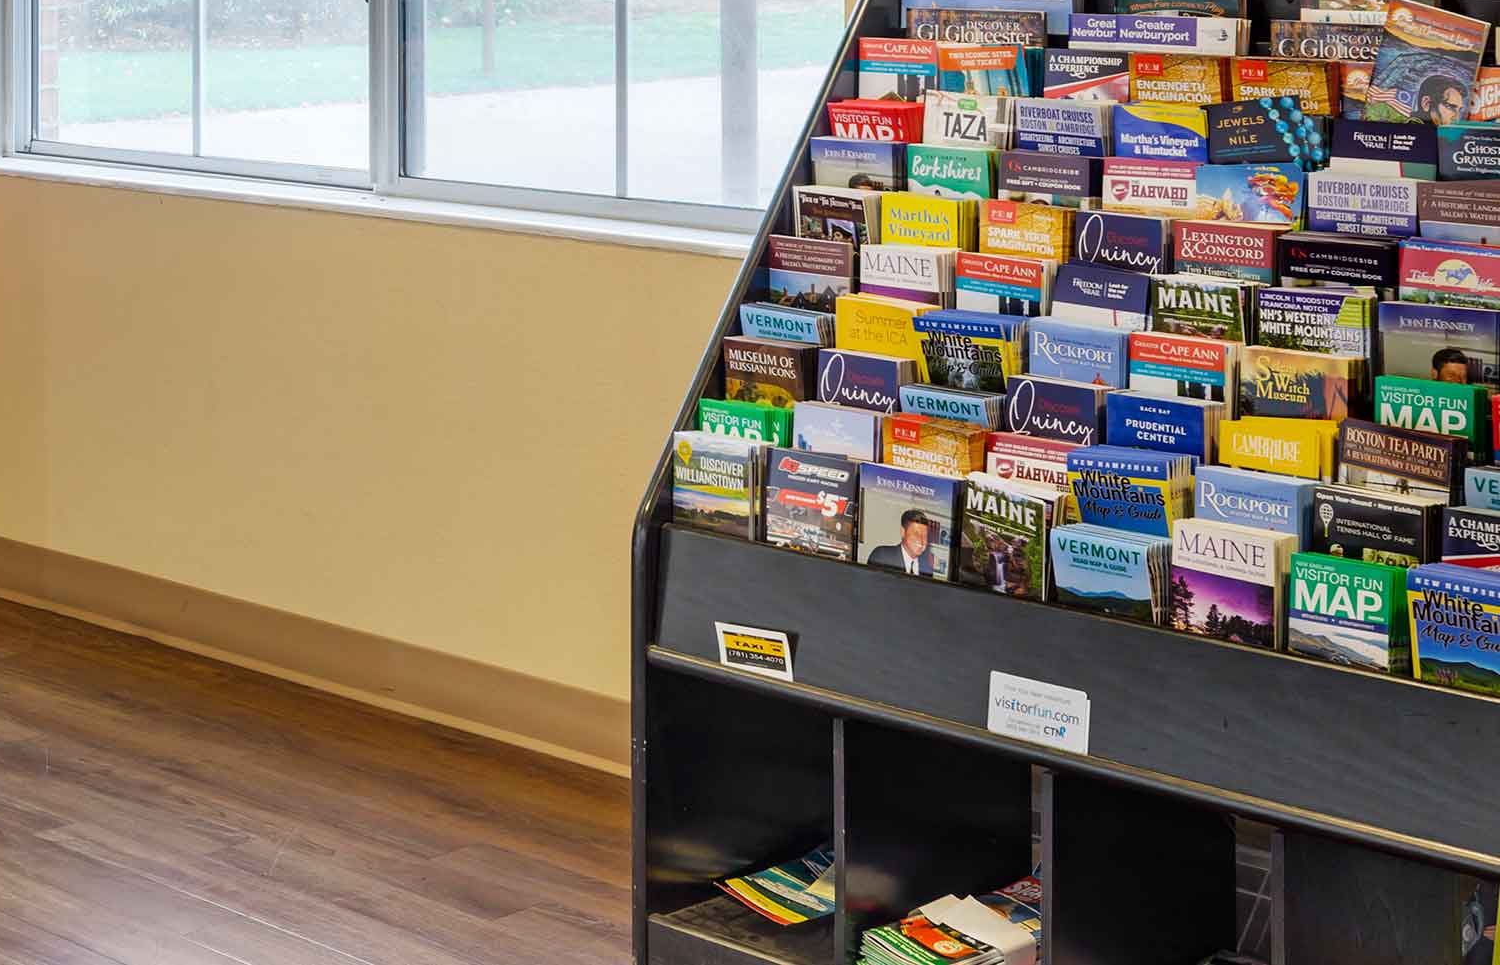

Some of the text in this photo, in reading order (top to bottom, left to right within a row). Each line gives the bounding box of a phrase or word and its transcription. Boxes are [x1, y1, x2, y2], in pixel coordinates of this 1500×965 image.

[945, 24, 1033, 44] Gloucester
[966, 20, 1020, 31] DISCOVER
[1134, 20, 1175, 31] Greater
[1120, 29, 1190, 42] Newburyport
[884, 43, 932, 54] CAPE ANN
[1058, 56, 1123, 66] CHAMPIONSHIP
[1050, 64, 1099, 78] EXPERIENCE
[1240, 86, 1276, 97] SPARK
[832, 113, 892, 125] VISITOR FUN
[1020, 106, 1094, 124] RIVERBOAT CRUISES
[1216, 116, 1265, 129] JEWELS
[834, 123, 894, 141] MAP
[943, 112, 987, 142] TAZA
[1020, 118, 1095, 135] BOSTON CAMBRIDGE
[1058, 137, 1096, 147] ARCHITECTURE
[1121, 134, 1199, 148] Martha's Vineyard
[1229, 134, 1258, 145] NILE
[1353, 132, 1387, 143] FREEDOM
[824, 148, 842, 158] JOHN
[1038, 144, 1080, 155] SUNSET CRUISES
[1142, 148, 1187, 157] Nantucket
[912, 155, 981, 181] Berkshires
[1023, 165, 1079, 175] CAMBRIDGESIDE
[1007, 178, 1023, 186] FREE
[1038, 181, 1064, 189] COUPON
[1132, 185, 1187, 199] HARVARD
[1317, 181, 1409, 199] RIVERBOAT CRUISES
[1317, 196, 1409, 212] BOSTON CAMBRIDGE
[890, 208, 948, 224] Martha's
[1316, 211, 1409, 227] SIGHTSEEING ARCHITECTURE
[888, 223, 951, 242] Vineyard
[988, 226, 1049, 239] SPARK YOUR
[1181, 227, 1264, 248] LEXINGTON
[1336, 223, 1388, 235] SUNSET CRUISES
[988, 239, 1054, 254] IMAGINATION
[1078, 213, 1162, 275] Quincy
[865, 251, 932, 278] MAINE
[1309, 252, 1378, 265] CAMBRIDGESIDE
[984, 261, 1010, 274] CAPE
[1012, 265, 1036, 278] ANN
[1187, 265, 1202, 274] Two
[1331, 270, 1361, 278] COUPON
[1362, 273, 1383, 281] BOOK
[1073, 278, 1103, 291] FREEDOM
[1158, 287, 1234, 318] MAINE
[1260, 293, 1341, 306] LINCOLN WOODSTOCK
[1260, 301, 1300, 310] FRANCONIA
[745, 313, 813, 335] VERMONT
[855, 310, 907, 328] Summer
[1260, 309, 1331, 325] NH'S WESTERN
[1400, 316, 1475, 332] JOHN KENNEDY
[941, 322, 996, 332] HAMPSHIRE
[1260, 321, 1360, 343] WHITE MOUNTAINS
[851, 329, 908, 346] at the ICA
[927, 330, 971, 348] White
[921, 340, 1002, 363] Mountains
[1033, 331, 1114, 365] ROCKPORT
[1160, 343, 1190, 356] CAPE
[1193, 348, 1219, 360] ANN
[729, 349, 794, 368] MUSEUM OF
[730, 361, 796, 380] RUSSIAN ICONS
[821, 354, 896, 414] Quincy
[905, 394, 981, 417] VERMONT
[1380, 392, 1467, 410] VISITOR FUN
[703, 412, 761, 429] VISITOR FUN
[1009, 380, 1094, 446] Quincy
[1380, 403, 1467, 435] MAP
[702, 422, 762, 441] MAP
[1125, 418, 1187, 436] PRUDENTIAL
[1137, 430, 1176, 444] CENTER
[1346, 427, 1385, 448] BOSTON
[1388, 436, 1409, 453] TEA
[1412, 442, 1447, 463] PARTY
[700, 457, 744, 477] DISCOVER
[1073, 459, 1159, 473] NEW HAMPSHIRE
[1352, 451, 1444, 478] REVOLUTIONARY EXPERIENCE
[675, 466, 744, 491] WILLIAMSTOWN
[876, 476, 935, 497] JOHN KENNEDY
[1081, 469, 1131, 490] White
[1072, 481, 1165, 507] Mountains
[1199, 480, 1292, 518] ROCKPORT
[967, 488, 1037, 531] MAINE
[1084, 501, 1163, 520] Map & Guide
[1336, 518, 1392, 533] INTERNATIONAL
[1449, 517, 1456, 527] A
[1336, 526, 1360, 535] TENNIS
[1362, 531, 1380, 539] HALL
[1394, 536, 1416, 545] FAME
[1057, 538, 1141, 566] VERMONT
[1179, 530, 1265, 569] MAINE
[1109, 564, 1127, 572] GUIDE
[1295, 567, 1383, 592] VISITOR FUN
[1415, 577, 1440, 587] NEW
[1295, 580, 1382, 621] MAP
[1423, 588, 1484, 617] White
[1421, 625, 1473, 647] Map &
[728, 650, 748, 658] (781)
[734, 641, 764, 650] TAXI
[995, 696, 1080, 725] visitorfun.com
